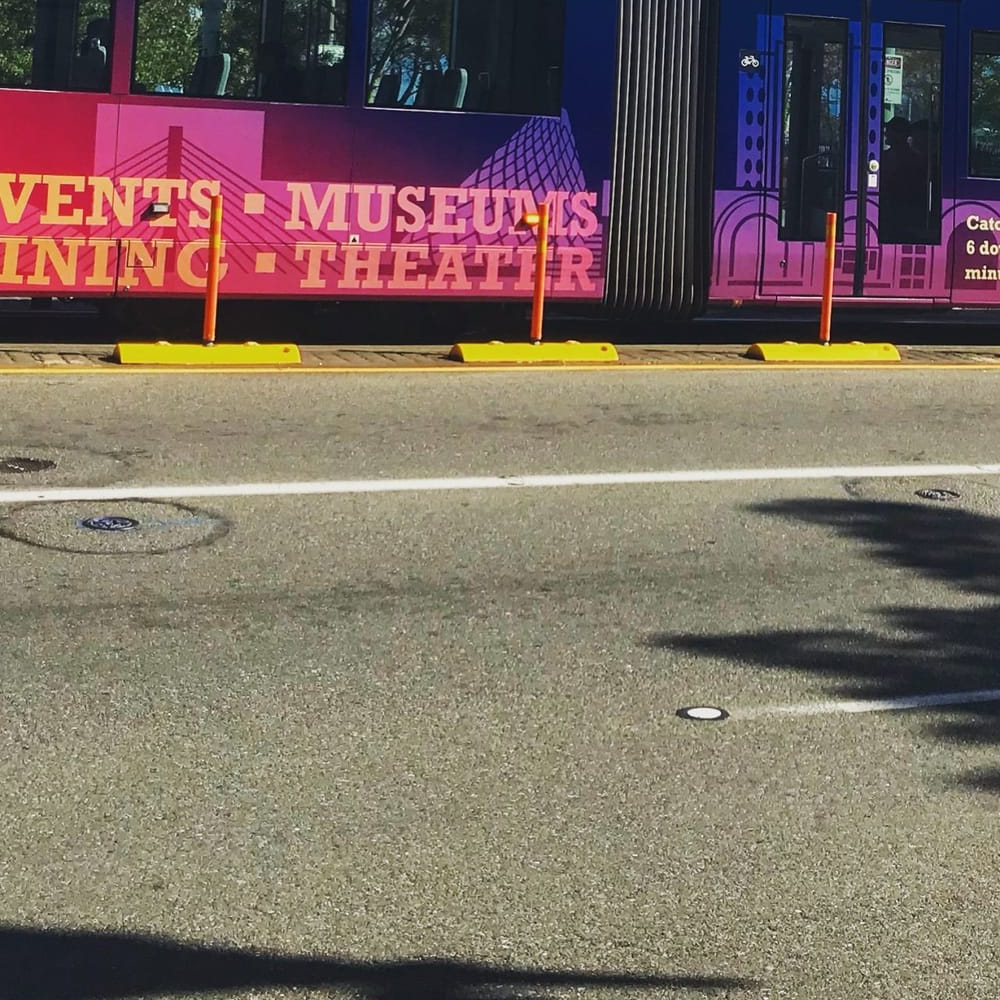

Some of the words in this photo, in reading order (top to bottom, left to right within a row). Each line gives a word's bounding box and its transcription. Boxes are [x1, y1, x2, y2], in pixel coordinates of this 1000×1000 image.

[284, 182, 598, 238] MUSEUMS
[295, 242, 596, 291] THEATER
[966, 240, 975, 255] 6
